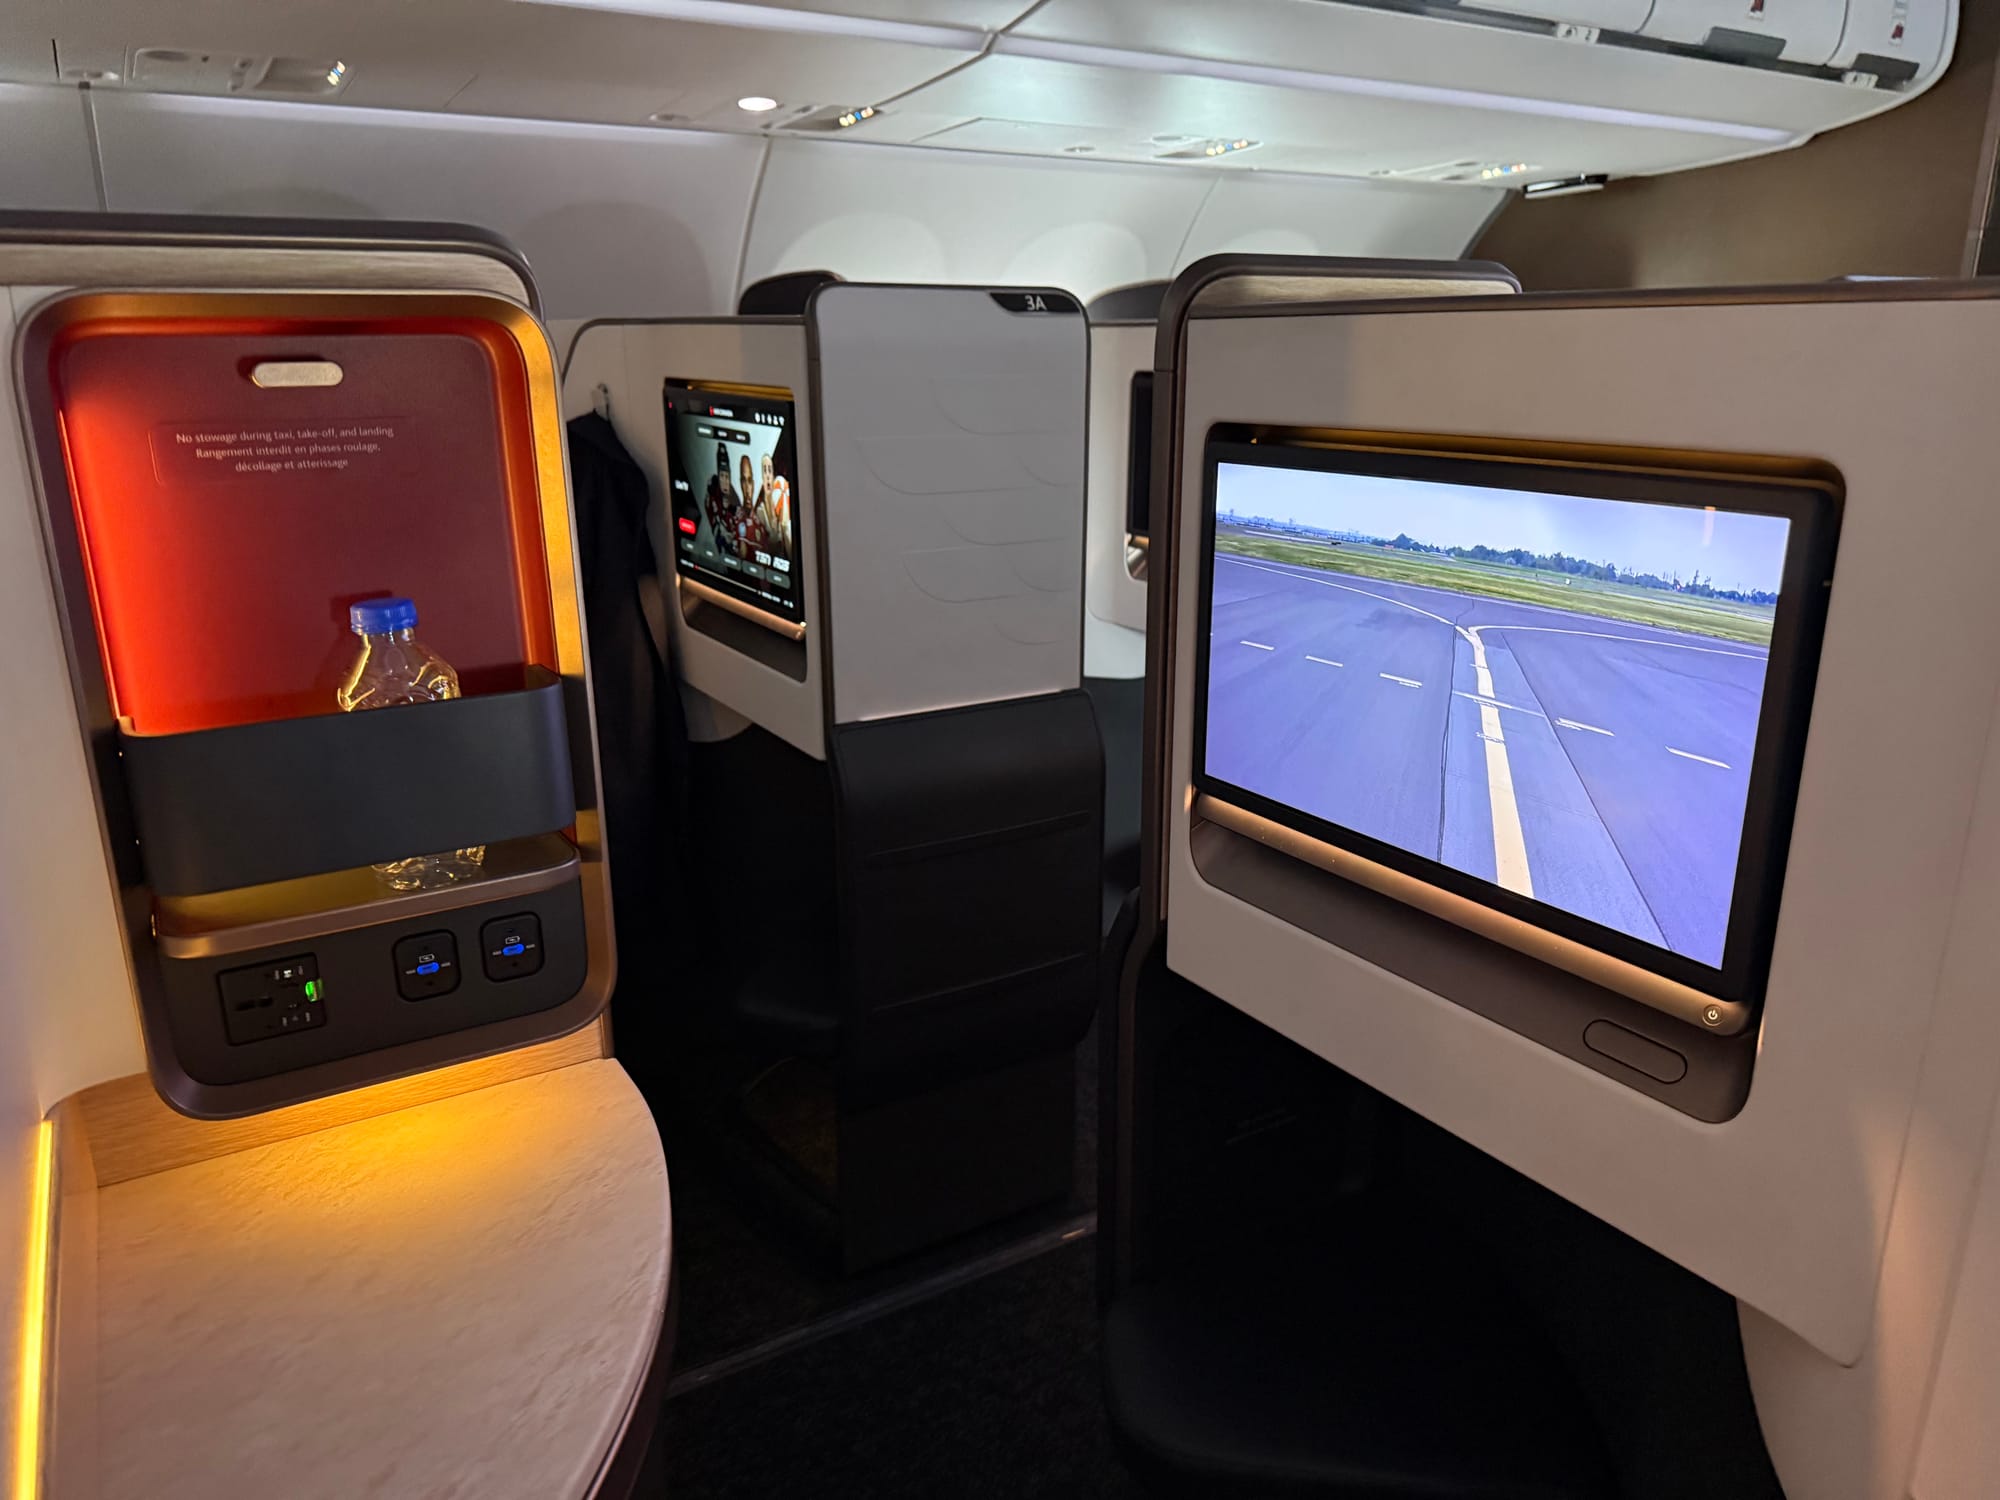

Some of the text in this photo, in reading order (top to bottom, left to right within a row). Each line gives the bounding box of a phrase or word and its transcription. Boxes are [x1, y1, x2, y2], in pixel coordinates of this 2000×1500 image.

[1024, 294, 1048, 311] 3A
[176, 425, 394, 444] No stowage during taxi, take-off, and landing
[196, 447, 254, 460] Rangement
[256, 444, 291, 456] interdit
[294, 444, 307, 454] en
[309, 442, 341, 455] phases
[235, 460, 282, 472] décollage
[284, 460, 295, 470] et
